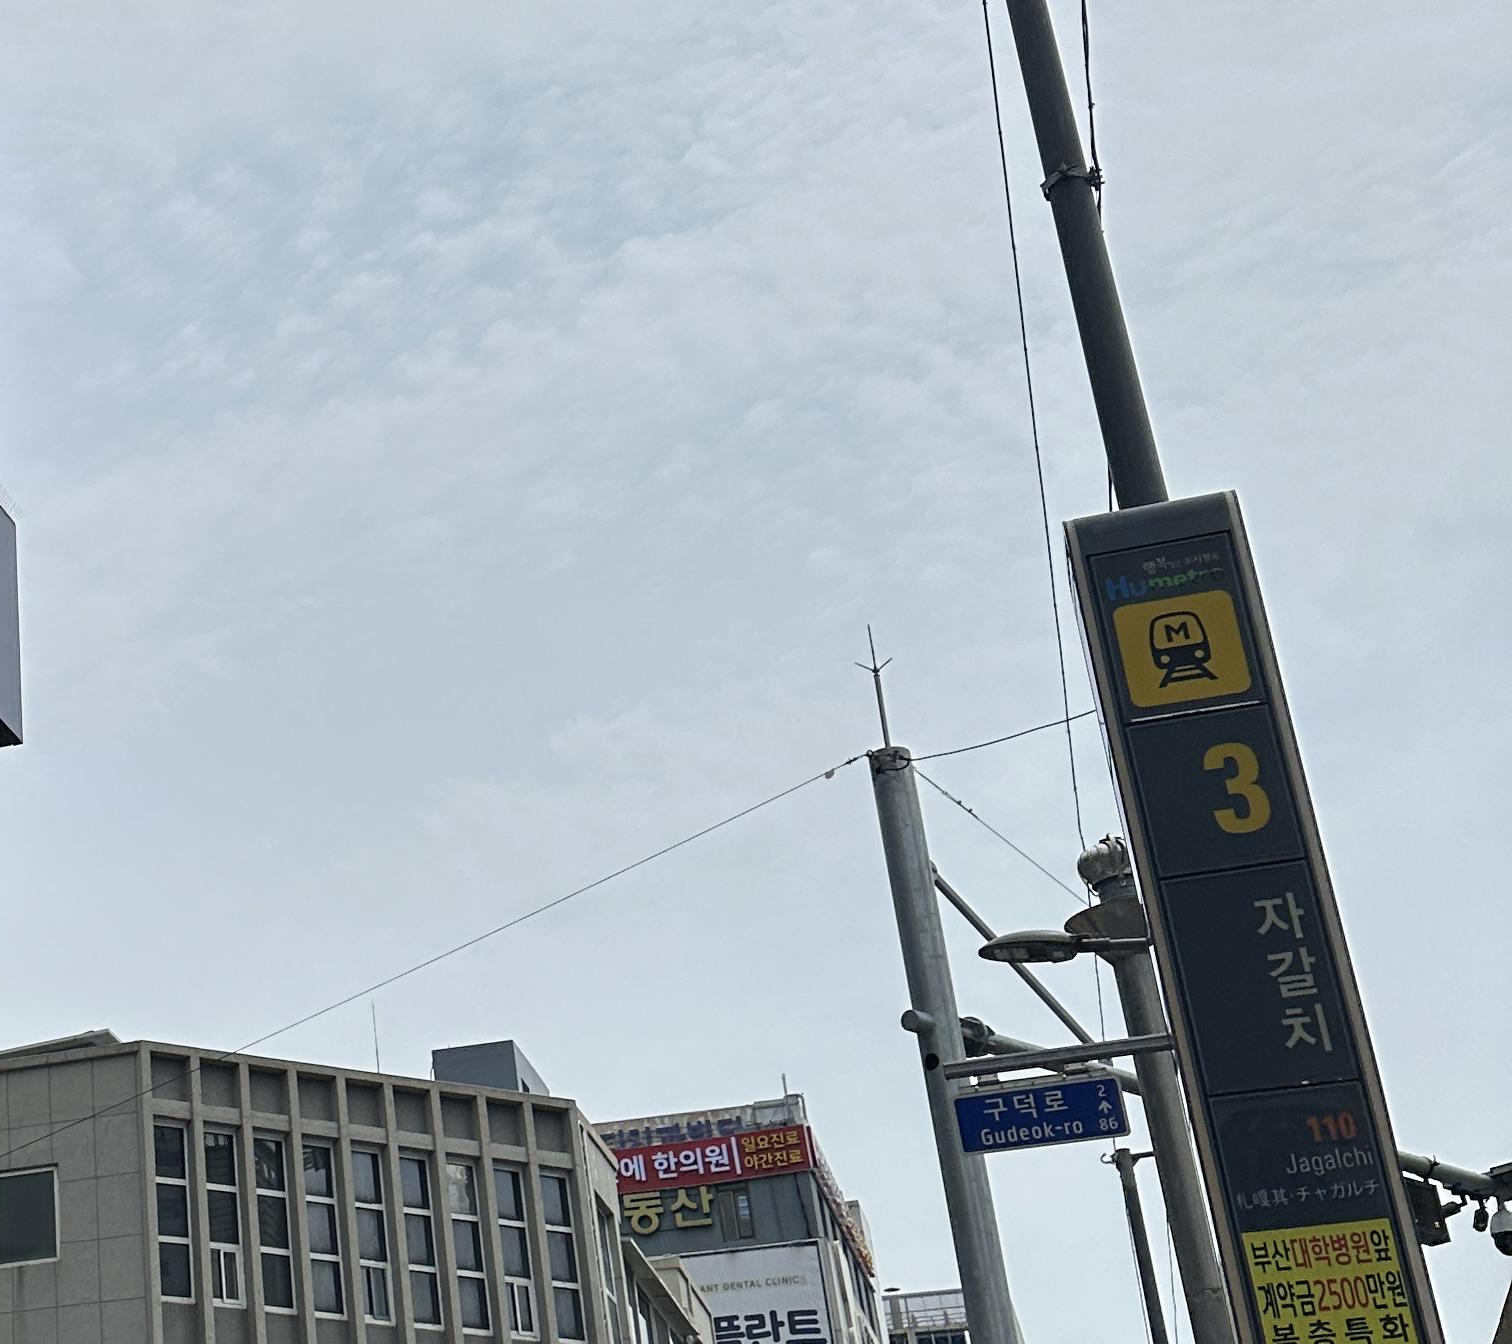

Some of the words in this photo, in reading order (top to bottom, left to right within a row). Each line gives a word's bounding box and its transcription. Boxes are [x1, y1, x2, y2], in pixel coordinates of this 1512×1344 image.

[1203, 742, 1271, 834] 3
[1253, 892, 1334, 1052] 자갈치
[983, 1090, 1069, 1121] 구덕로
[1096, 1085, 1107, 1097] 2
[981, 1121, 1084, 1146] Gudeok-ro
[1099, 1117, 1119, 1131] 86
[1305, 1111, 1358, 1142] 110
[741, 1131, 800, 1153] 일요진료
[615, 1154, 646, 1182] 에
[651, 1143, 731, 1180] 한의원
[744, 1149, 804, 1171] 야간진료
[1286, 1146, 1374, 1176] Jagalchi
[623, 1185, 714, 1236] 동산
[1251, 1229, 1392, 1274] 부산대학병원앞
